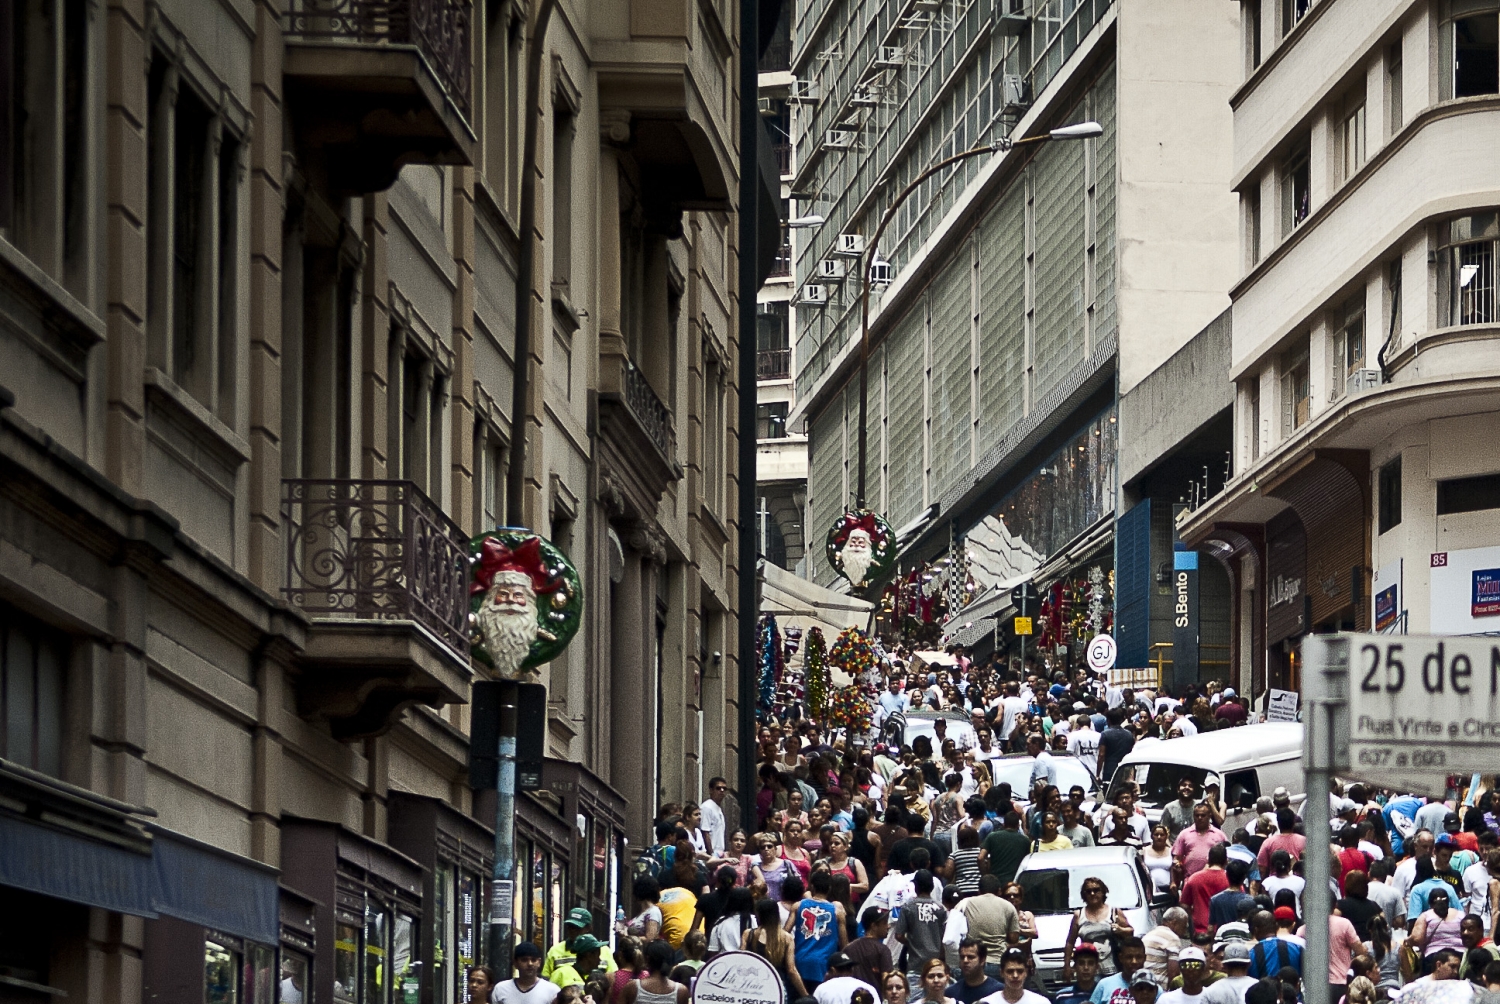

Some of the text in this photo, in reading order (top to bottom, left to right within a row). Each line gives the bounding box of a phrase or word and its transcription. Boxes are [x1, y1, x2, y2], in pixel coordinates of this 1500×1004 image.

[1432, 554, 1445, 566] 85
[1175, 572, 1189, 628] S.Bento
[1093, 645, 1110, 660] GJ
[1361, 643, 1405, 694] 25
[1422, 641, 1472, 695] de
[1358, 715, 1395, 735] Rua
[1398, 717, 1443, 737] Vinte
[1447, 720, 1459, 737] e
[1358, 749, 1393, 766] 637
[701, 993, 735, 1003] cabelos
